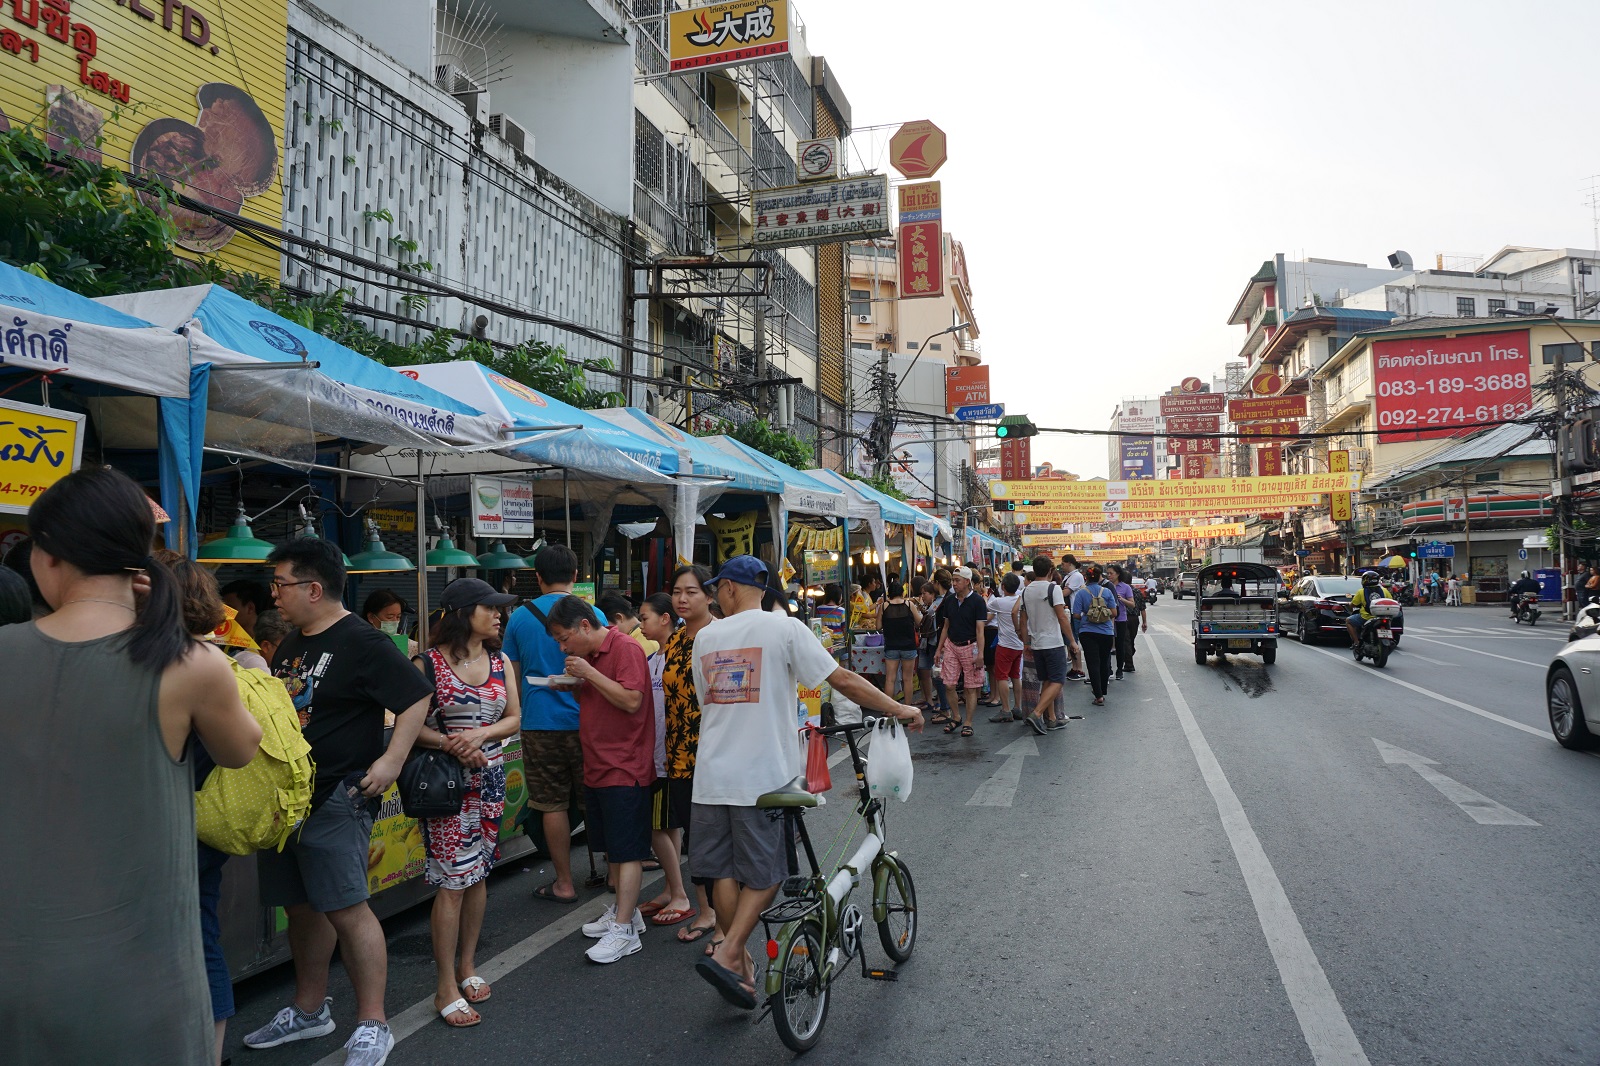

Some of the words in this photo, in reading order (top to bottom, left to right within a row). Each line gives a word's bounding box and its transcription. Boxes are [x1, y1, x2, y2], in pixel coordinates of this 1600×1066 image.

[715, 5, 775, 46] 大成
[674, 59, 698, 69] Hot
[705, 54, 728, 64] Pot
[735, 45, 784, 59] Buffet
[807, 224, 829, 237] BURI
[0, 316, 73, 363] ศักดิ์
[1378, 349, 1482, 369] ติดต่อโฆษณา
[1488, 345, 1524, 361] โทร.
[955, 384, 987, 392] EXCHANGE
[965, 391, 987, 401] ATM
[1378, 372, 1527, 397] 083-189-3688
[1379, 402, 1529, 426] 092-274-6183
[1169, 439, 1215, 453] 中國城
